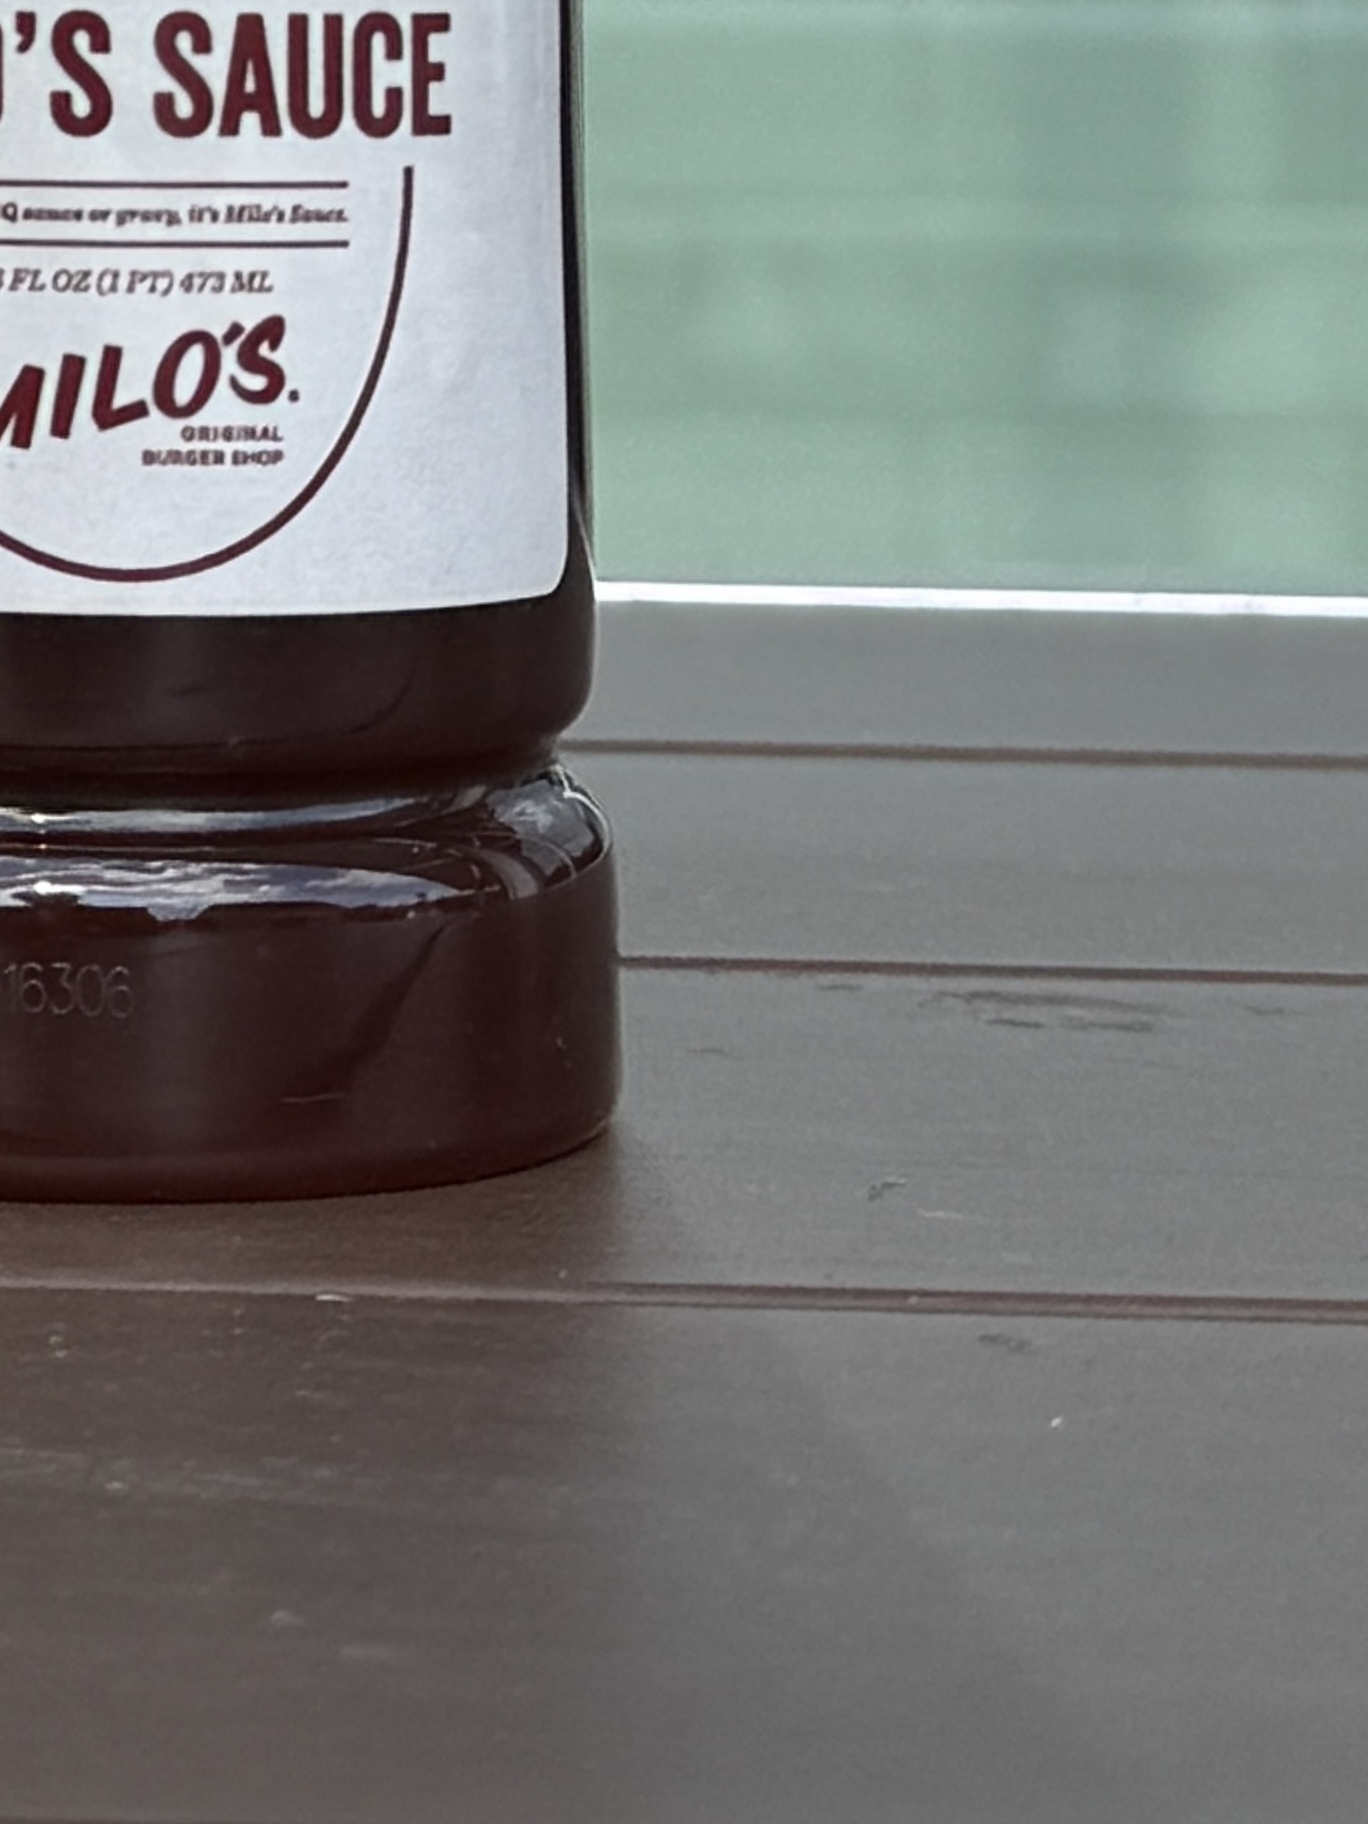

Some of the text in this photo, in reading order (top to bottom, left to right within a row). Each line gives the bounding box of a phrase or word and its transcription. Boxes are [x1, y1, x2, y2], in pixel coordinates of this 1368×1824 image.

[152, 9, 452, 140] SAUCE
[8, 267, 47, 293] FL
[51, 267, 93, 294] OZ
[95, 267, 122, 297] (1
[125, 269, 174, 297] PT)
[180, 269, 225, 294] 473
[230, 269, 275, 294] ML
